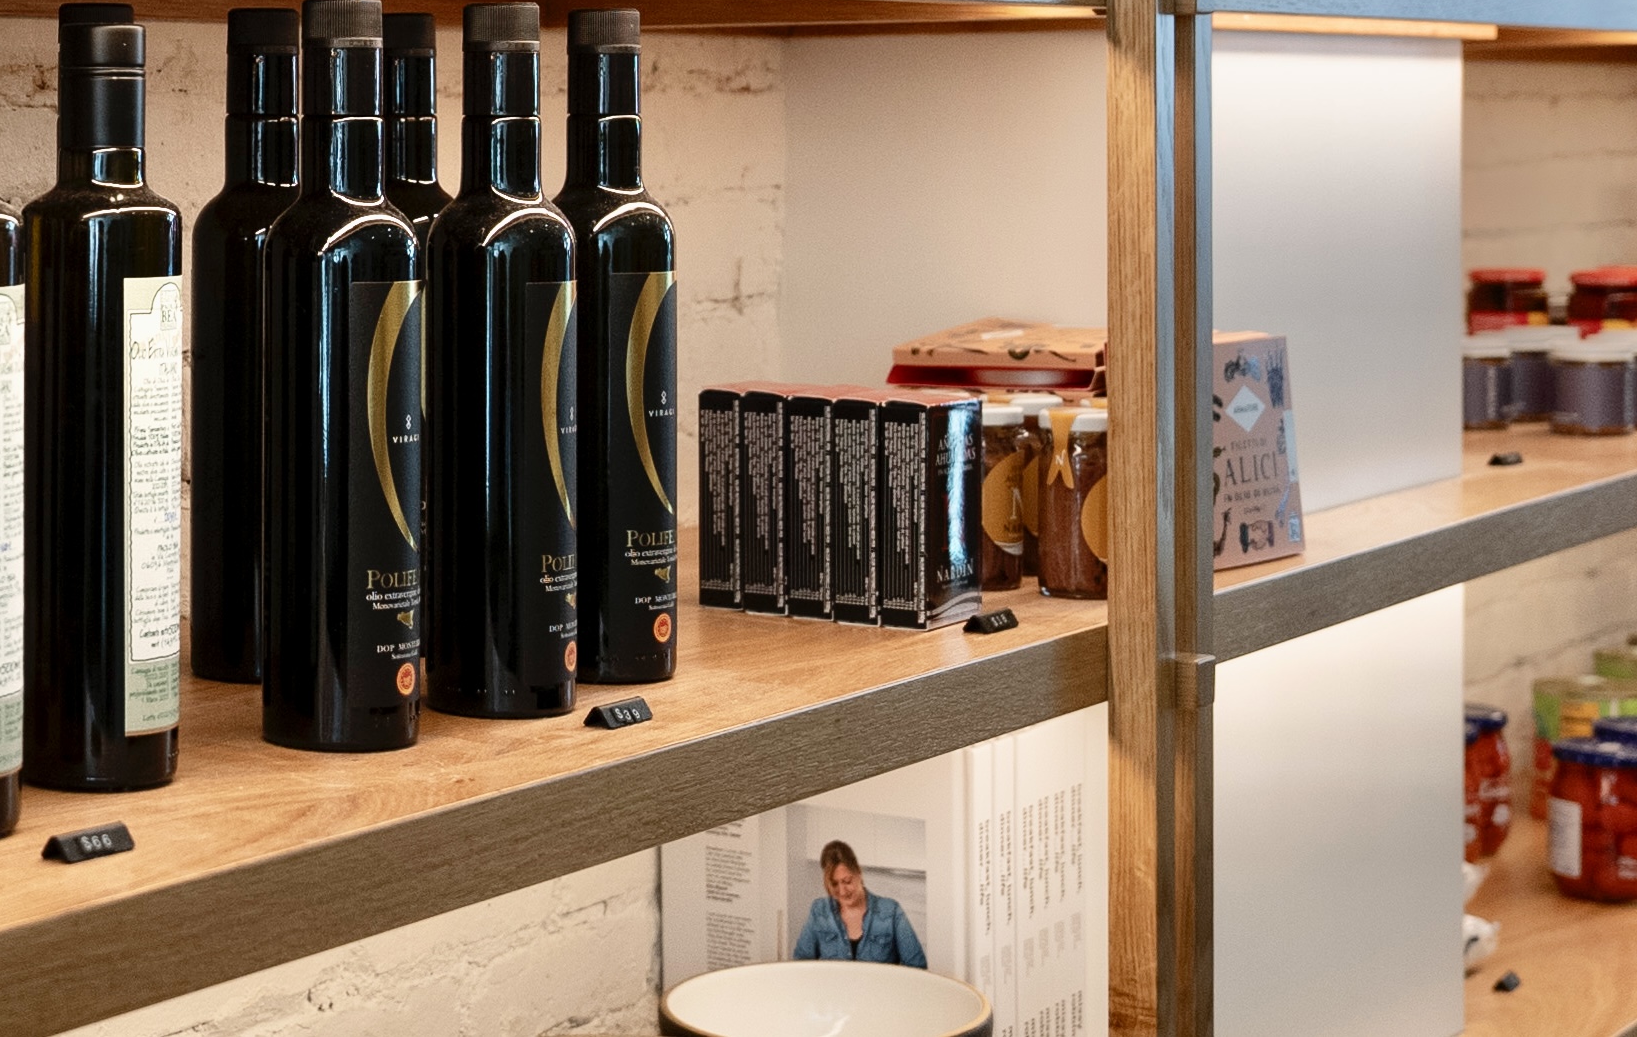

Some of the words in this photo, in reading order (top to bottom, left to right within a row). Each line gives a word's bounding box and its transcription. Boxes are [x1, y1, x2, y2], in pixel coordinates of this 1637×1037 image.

[161, 308, 177, 324] BEA
[1224, 450, 1279, 487] ALICI
[366, 590, 384, 602] olio
[634, 596, 652, 605] DOP
[376, 644, 396, 654] DOP
[614, 707, 640, 721] $39
[80, 833, 113, 852] $66
